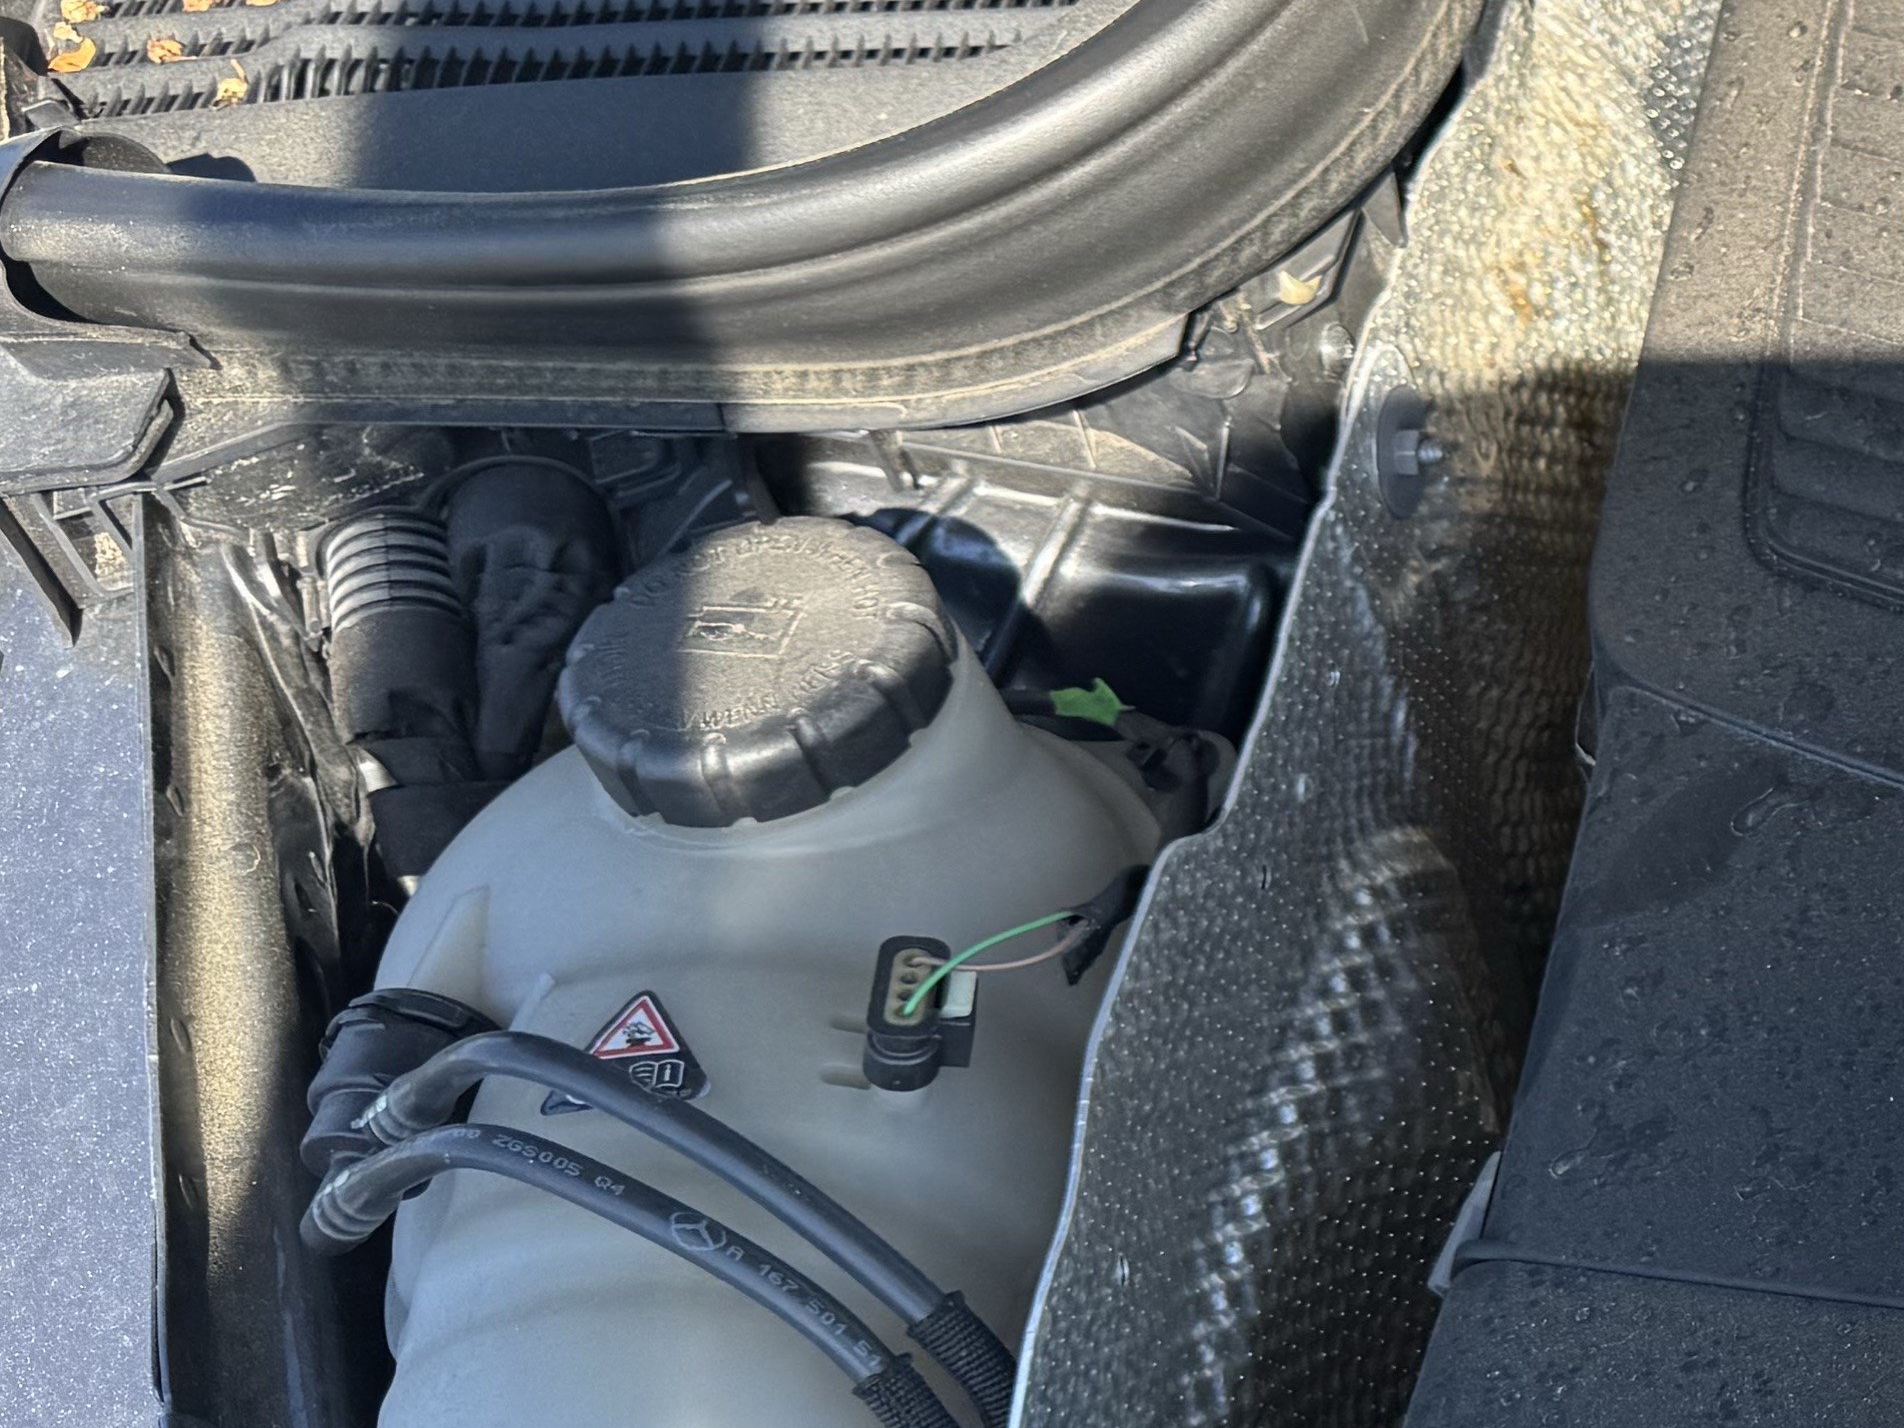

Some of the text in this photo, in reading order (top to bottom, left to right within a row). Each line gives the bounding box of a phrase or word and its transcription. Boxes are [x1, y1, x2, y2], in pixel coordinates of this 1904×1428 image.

[491, 1133, 583, 1177] ZGS005
[726, 1244, 745, 1262] A
[757, 1263, 799, 1293] 167
[806, 1296, 848, 1336] 501
